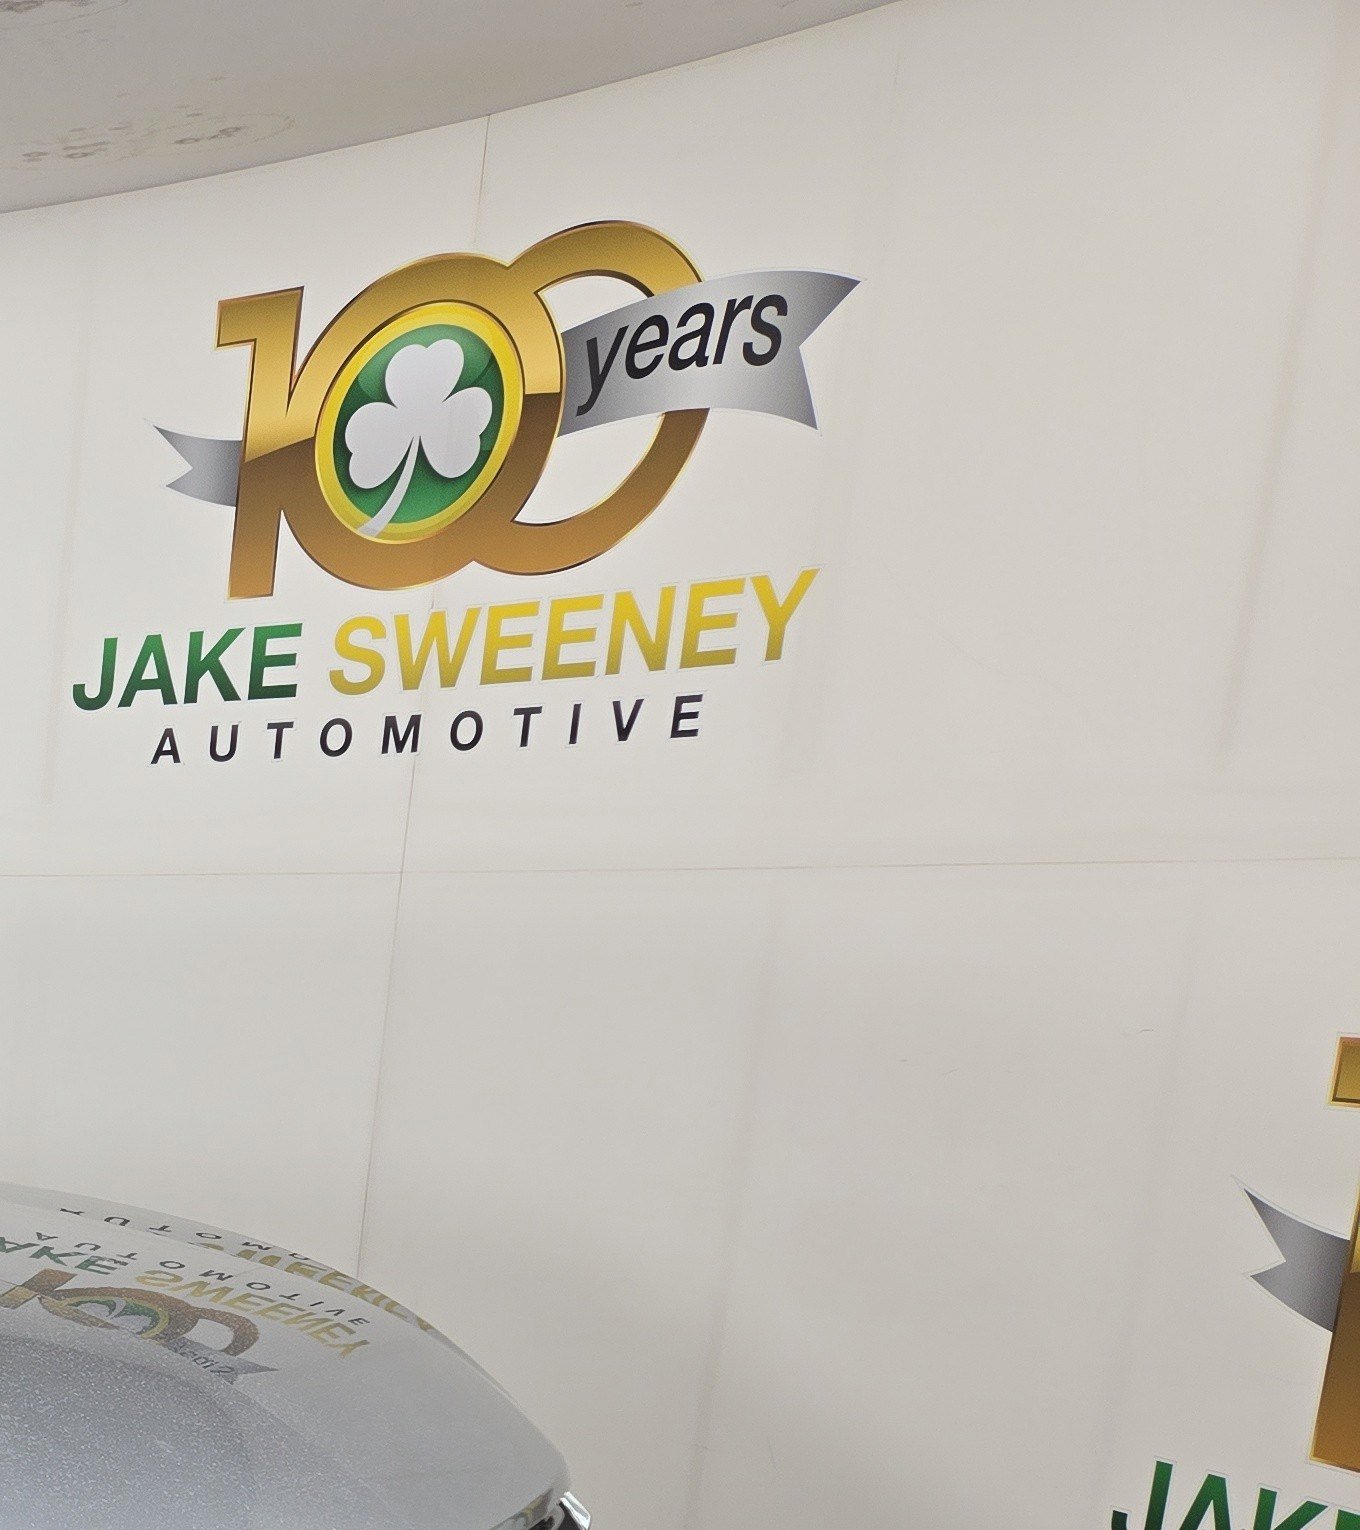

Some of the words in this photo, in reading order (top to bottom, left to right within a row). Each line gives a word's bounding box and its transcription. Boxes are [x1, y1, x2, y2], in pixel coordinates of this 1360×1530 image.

[577, 292, 787, 417] years
[73, 623, 302, 711] JAKE
[330, 569, 821, 698] SWEENEY
[152, 694, 704, 766] AUTOMOTIVE
